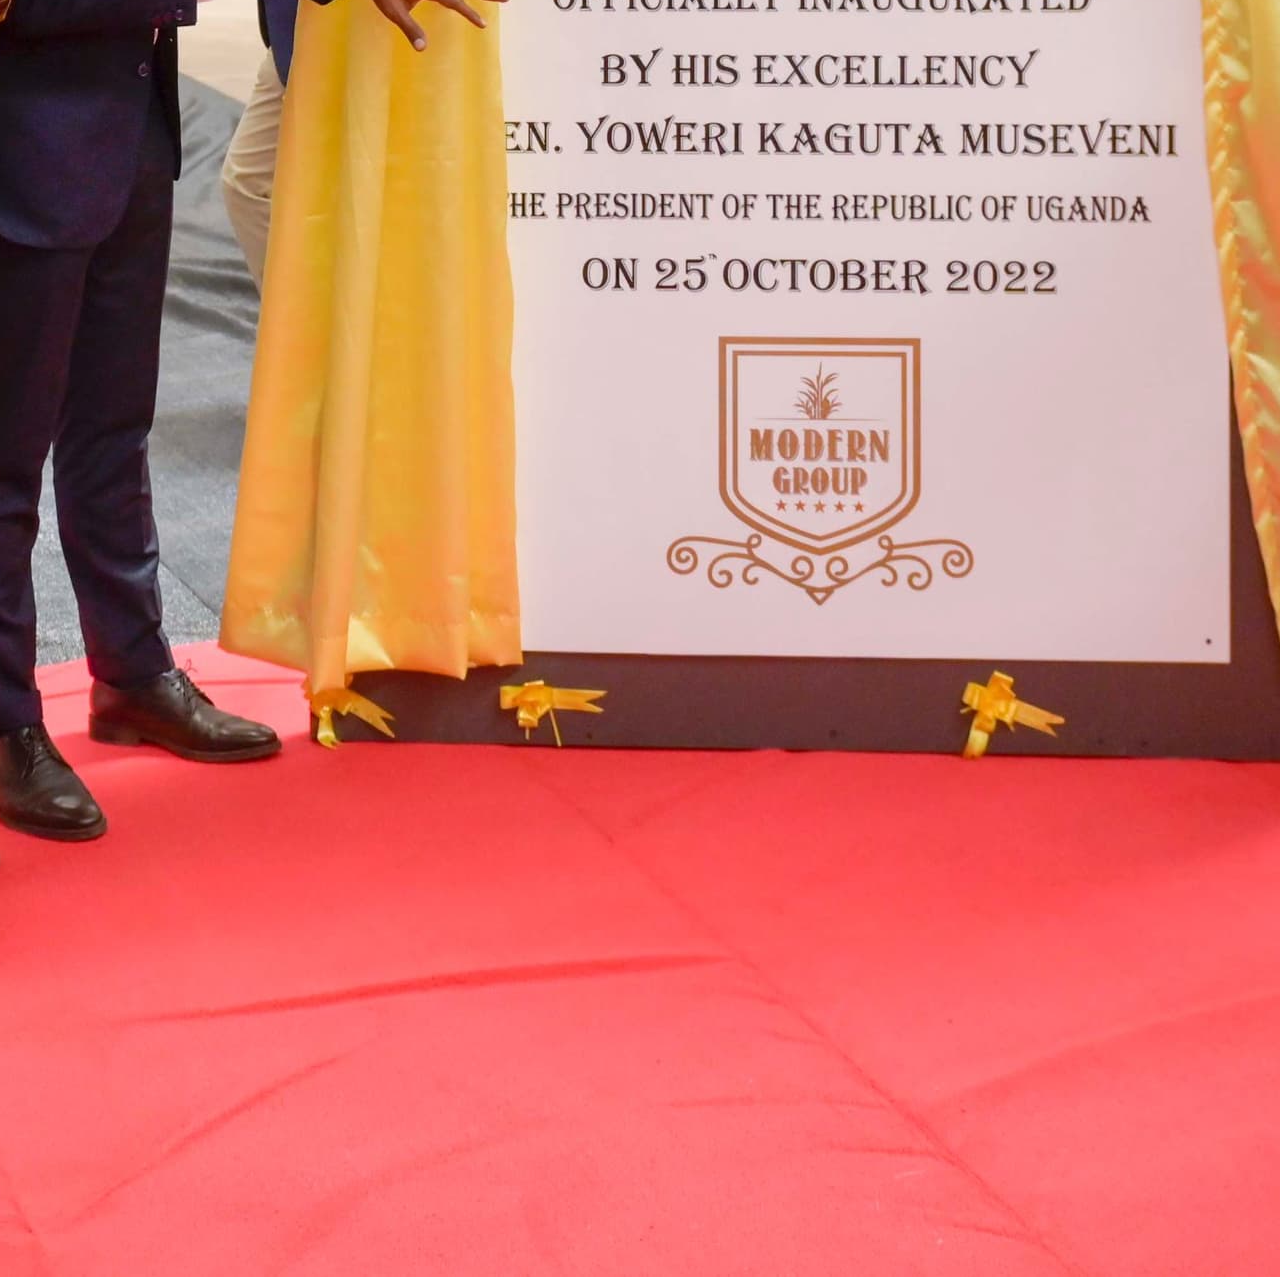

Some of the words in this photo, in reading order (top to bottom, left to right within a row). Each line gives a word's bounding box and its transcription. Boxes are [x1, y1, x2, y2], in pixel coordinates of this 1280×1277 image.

[599, 47, 664, 87] BY
[671, 53, 741, 88] HIS
[751, 49, 1041, 89] EXCELLENCY
[504, 120, 563, 155] EN.
[575, 115, 745, 157] YOWERI
[757, 122, 948, 157] KAGUTA
[958, 118, 1180, 158] MUSEVENI
[507, 192, 549, 219] HE
[555, 192, 715, 222] PRESIDENT
[721, 193, 759, 221] OF
[765, 193, 825, 221] THE
[831, 193, 973, 223] REPUBLIC
[980, 194, 1019, 223] OF
[1026, 195, 1153, 225] UGANDA
[581, 257, 639, 292] ON
[722, 257, 932, 296] OCTOBER
[945, 259, 1058, 295] 2022
[749, 428, 891, 463] MODERN
[771, 466, 868, 496] GROUP
